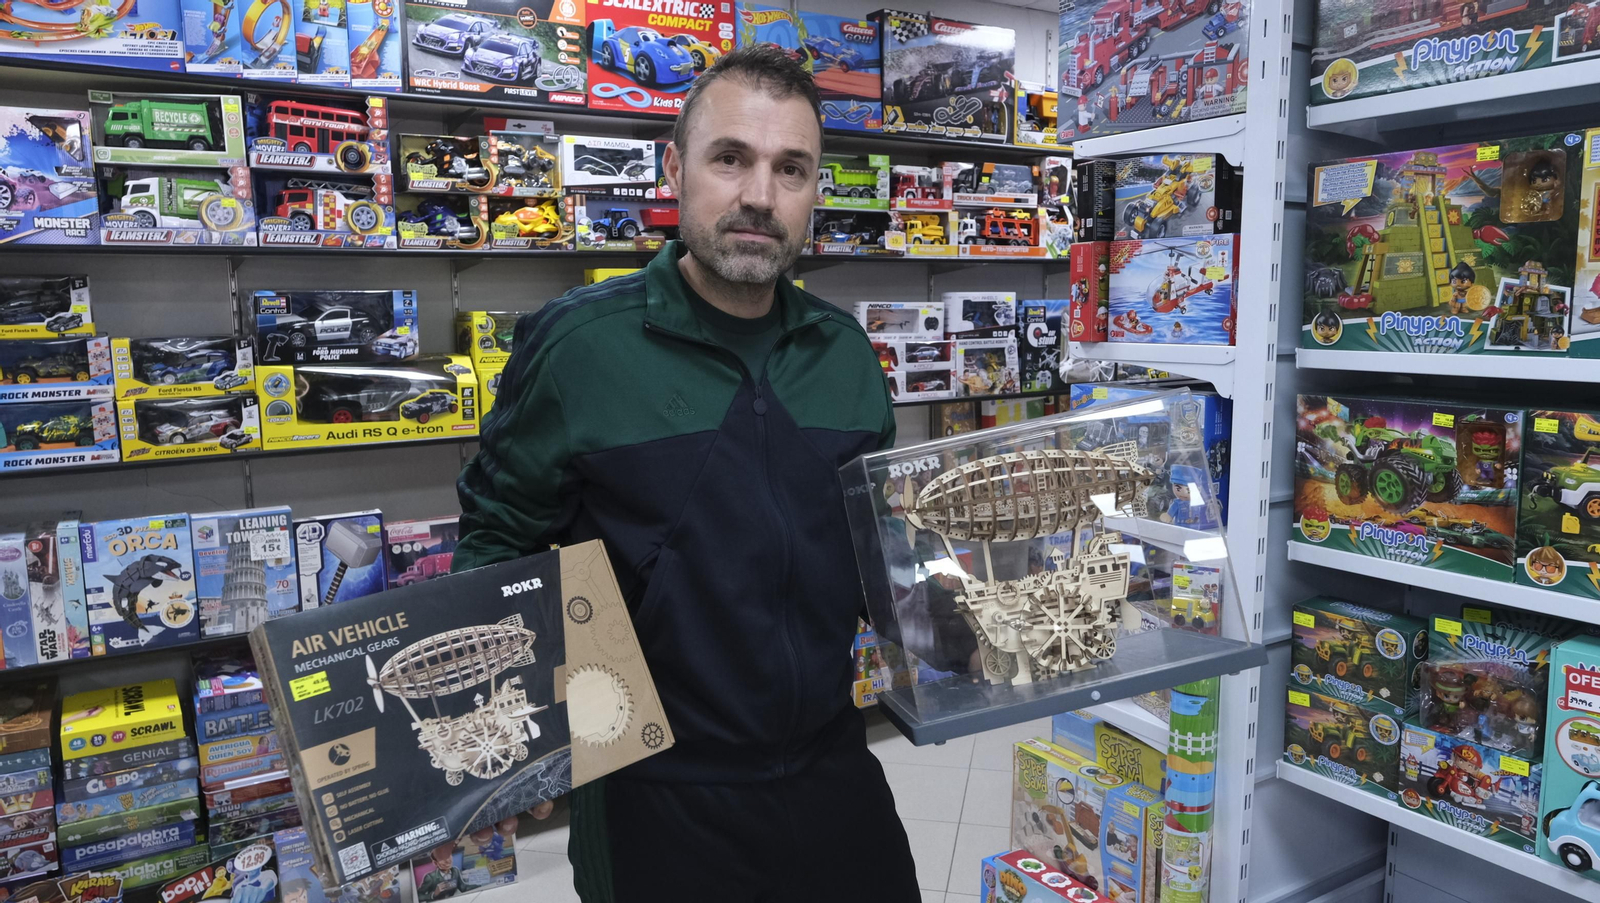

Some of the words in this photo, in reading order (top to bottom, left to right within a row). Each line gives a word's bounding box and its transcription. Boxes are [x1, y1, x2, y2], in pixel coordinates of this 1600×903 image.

[648, 14, 713, 32] COMPACT
[843, 23, 874, 35] Carrera
[934, 22, 973, 34] Carrer
[1411, 28, 1519, 71] Pinypon
[1453, 56, 1518, 78] ACTION
[413, 78, 431, 87] WRC
[432, 80, 458, 91] Hybrid
[459, 82, 481, 92] Boost
[504, 87, 520, 96] FIRST
[520, 89, 537, 97] LEVEL
[550, 94, 585, 104] NINCO
[653, 97, 673, 108] Kids
[154, 111, 188, 124] RECYCLE
[323, 121, 345, 129] TOUR
[255, 144, 285, 152] MOVERZ
[259, 152, 312, 166] TEAMSTERZ
[413, 181, 448, 189] TEAMSTERZ
[34, 217, 91, 230] MONSTER
[105, 220, 139, 229] MOVERZ
[262, 224, 292, 232] MOVERZ
[65, 228, 87, 237] RACE
[109, 229, 170, 242] TEAMSTERZ
[264, 233, 317, 244] TEAMSTERZ
[404, 239, 439, 247] TEAMSTERZ
[495, 239, 530, 247] TEAMSTERZ
[1211, 238, 1230, 246] FIRE
[261, 298, 281, 307] Revell
[1028, 308, 1042, 316] Revell
[319, 326, 350, 334] POLICE
[1379, 310, 1465, 337] Pinypon
[1413, 337, 1463, 349] ACTION
[0, 391, 29, 400] ROCK
[31, 389, 82, 399] MONSTER
[662, 405, 696, 417] adidas
[326, 429, 358, 441] Audi
[363, 428, 382, 437] RS
[386, 427, 398, 438] Q
[401, 424, 444, 436] e-tron
[154, 447, 186, 456] CITROËN
[202, 445, 218, 453] WRC
[3, 459, 33, 468] ROCK
[34, 454, 86, 465] MONSTER
[887, 455, 942, 480] ROKR
[239, 514, 288, 531] LEANING
[117, 526, 133, 537] 3D
[225, 529, 267, 544] TOW
[298, 523, 321, 541] 4D
[1359, 522, 1429, 553] Pinypon
[108, 532, 179, 556] ORCA
[198, 549, 228, 557] Develop
[1387, 548, 1429, 564] ACTION
[275, 579, 290, 589] 70
[501, 577, 544, 598] ROKR
[292, 634, 328, 659] AIR
[328, 611, 409, 647] VEHICLE
[39, 629, 50, 660] STAR
[47, 628, 59, 660] WARS
[1463, 634, 1530, 665] Pinypon
[294, 646, 366, 674] MECHANICAL
[366, 636, 400, 653] GEARS
[1324, 673, 1364, 696] Pinypon
[121, 685, 146, 717] SCRAWL
[314, 696, 365, 725] LK702
[130, 720, 177, 737] SCRAWL
[209, 739, 251, 753] AVERIGUA
[236, 747, 253, 755] SOY
[1016, 750, 1046, 777] Super
[1317, 755, 1358, 779] Pinypon
[316, 770, 344, 784] OPERATED
[344, 767, 352, 775] BY
[352, 761, 371, 771] SPRING
[85, 771, 139, 794] CLUEDO
[336, 789, 348, 798] SELF
[348, 781, 372, 795] ASSEMBLY
[376, 787, 390, 797] GLUE
[216, 803, 241, 815] 1000
[226, 811, 240, 820] KM
[343, 807, 375, 823] MECHANICAL
[1437, 799, 1486, 827] Pinypon
[347, 826, 363, 836] LASER
[363, 817, 384, 830] CUTTING
[394, 821, 440, 845] WARNING:
[75, 827, 180, 861] pasapalabra
[141, 835, 180, 849] FAMILIAR
[375, 846, 399, 860] CHOKING
[241, 851, 265, 871] 12.99
[139, 867, 174, 881] PEQUES
[70, 876, 115, 897] KARATE
[161, 876, 196, 903] bop
[999, 871, 1027, 896] DINO
